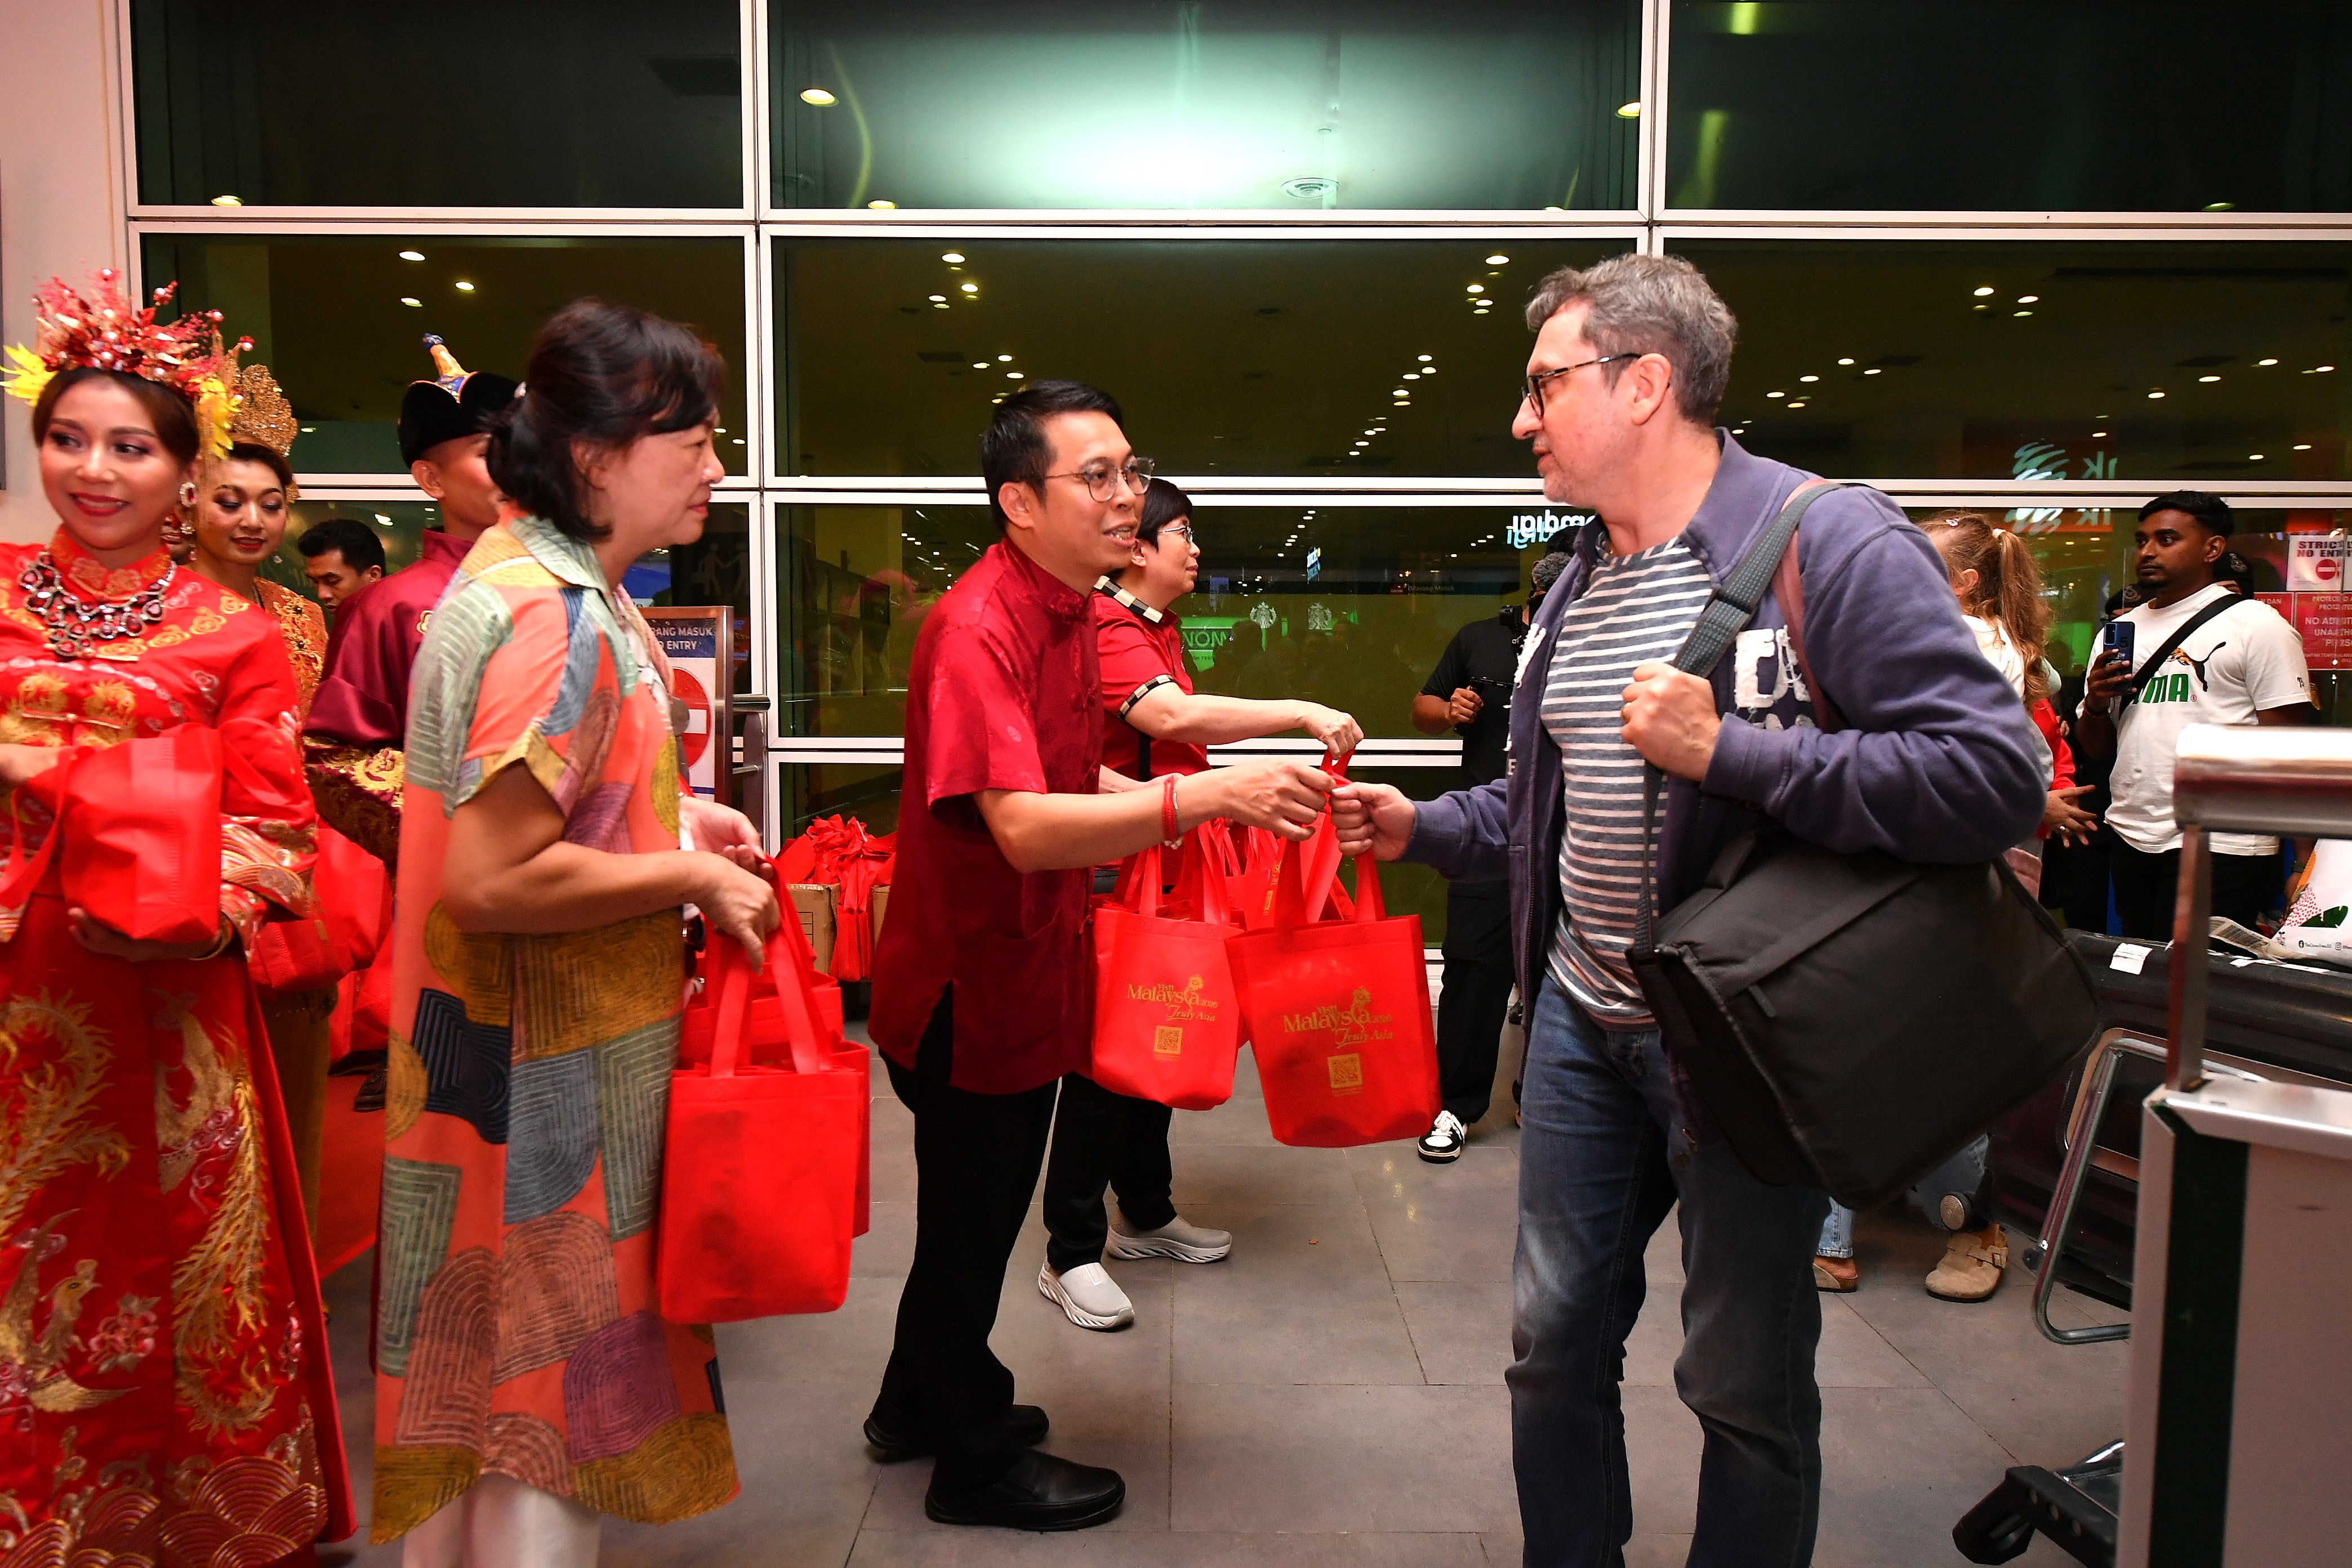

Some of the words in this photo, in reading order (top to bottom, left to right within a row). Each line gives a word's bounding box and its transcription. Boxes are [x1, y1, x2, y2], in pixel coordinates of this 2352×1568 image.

[678, 627, 713, 636] MASUK
[667, 640, 697, 650] ENTRY
[2132, 674, 2189, 705] MA
[1196, 1012, 1216, 1022] Asia
[1371, 1030, 1394, 1040] Asia
